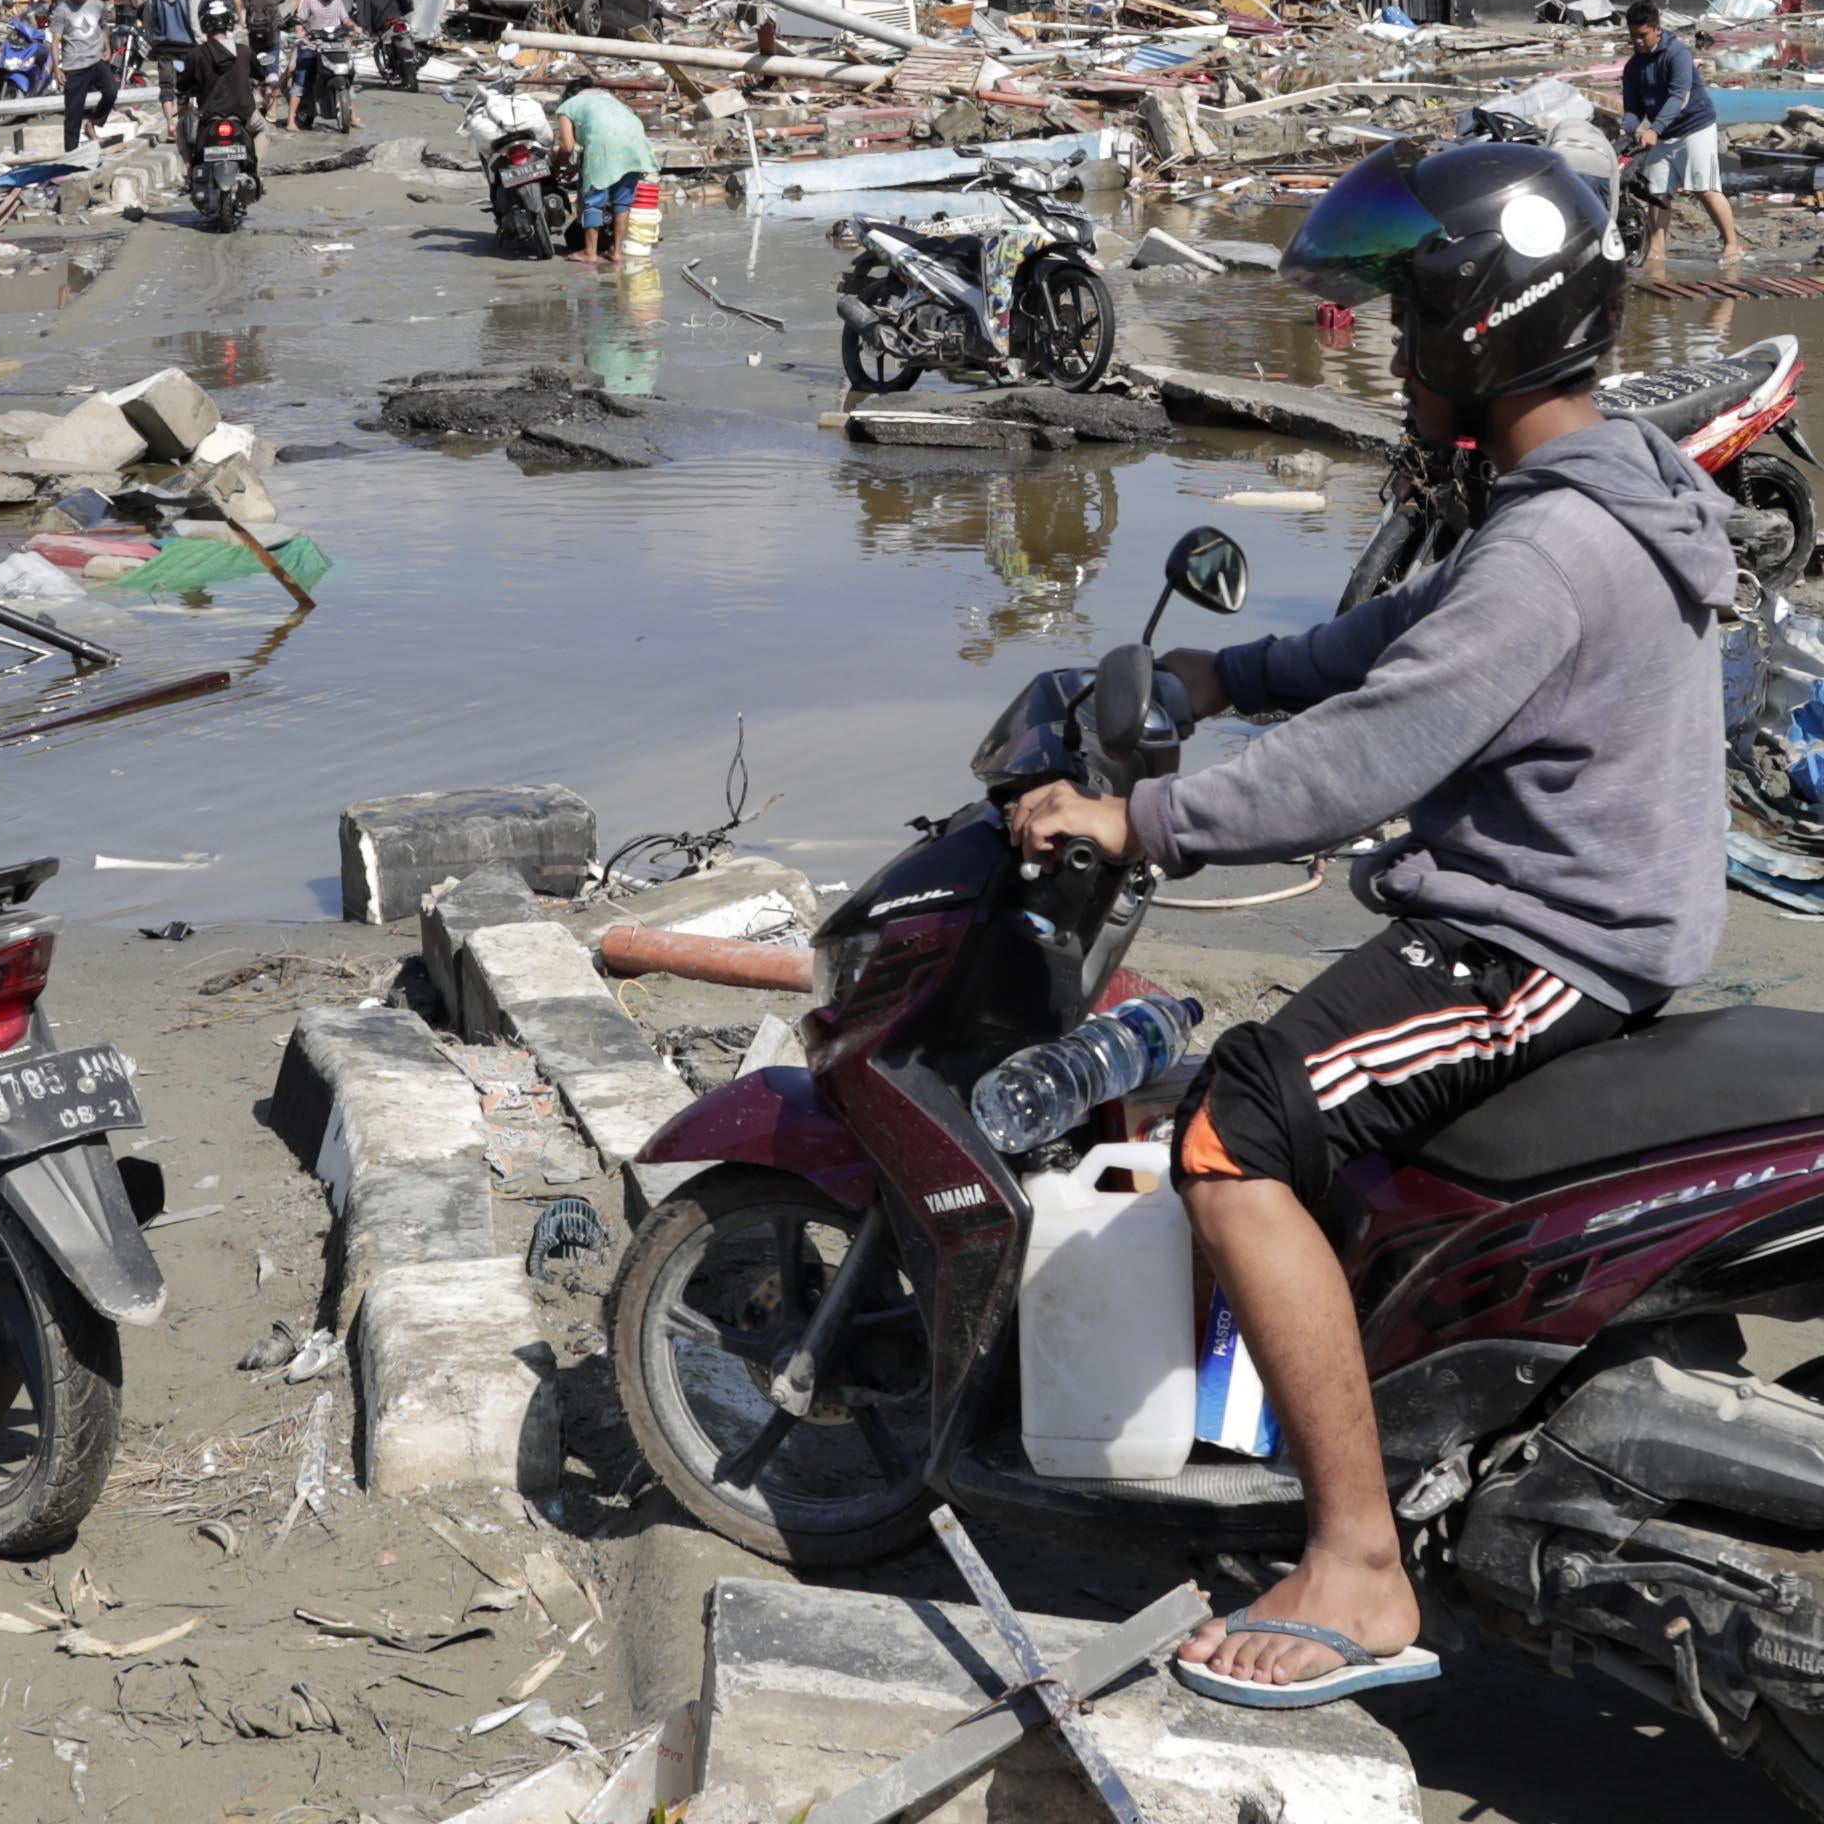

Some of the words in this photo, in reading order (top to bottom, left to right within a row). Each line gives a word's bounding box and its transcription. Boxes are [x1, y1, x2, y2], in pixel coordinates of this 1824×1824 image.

[1462, 271, 1565, 343] evolution
[868, 889, 954, 917] SOUL
[923, 1183, 986, 1214] YAMAHA
[1212, 1310, 1232, 1357] PASEO
